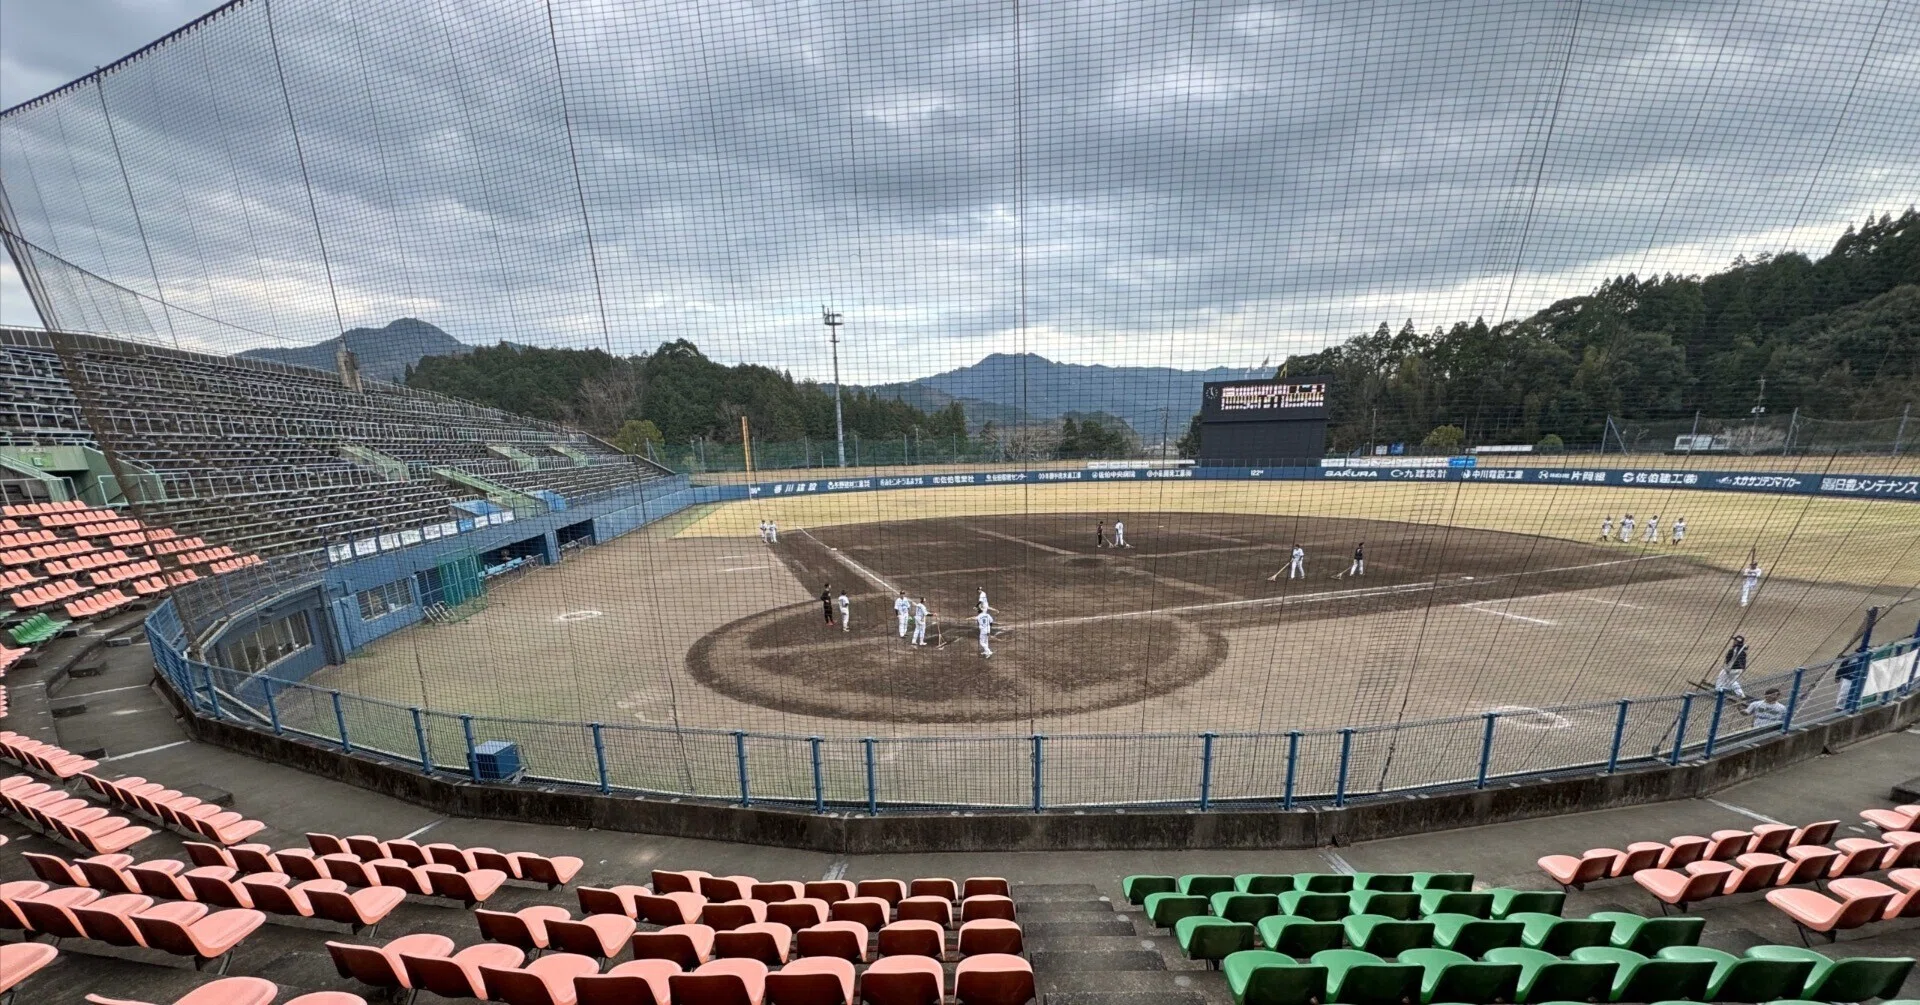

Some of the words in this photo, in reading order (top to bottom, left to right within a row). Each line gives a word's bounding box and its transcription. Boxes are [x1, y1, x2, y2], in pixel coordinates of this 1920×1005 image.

[1324, 469, 1378, 477] SAKURA
[1403, 469, 1447, 479] 九建設計
[1472, 470, 1524, 479] 中川電設工業
